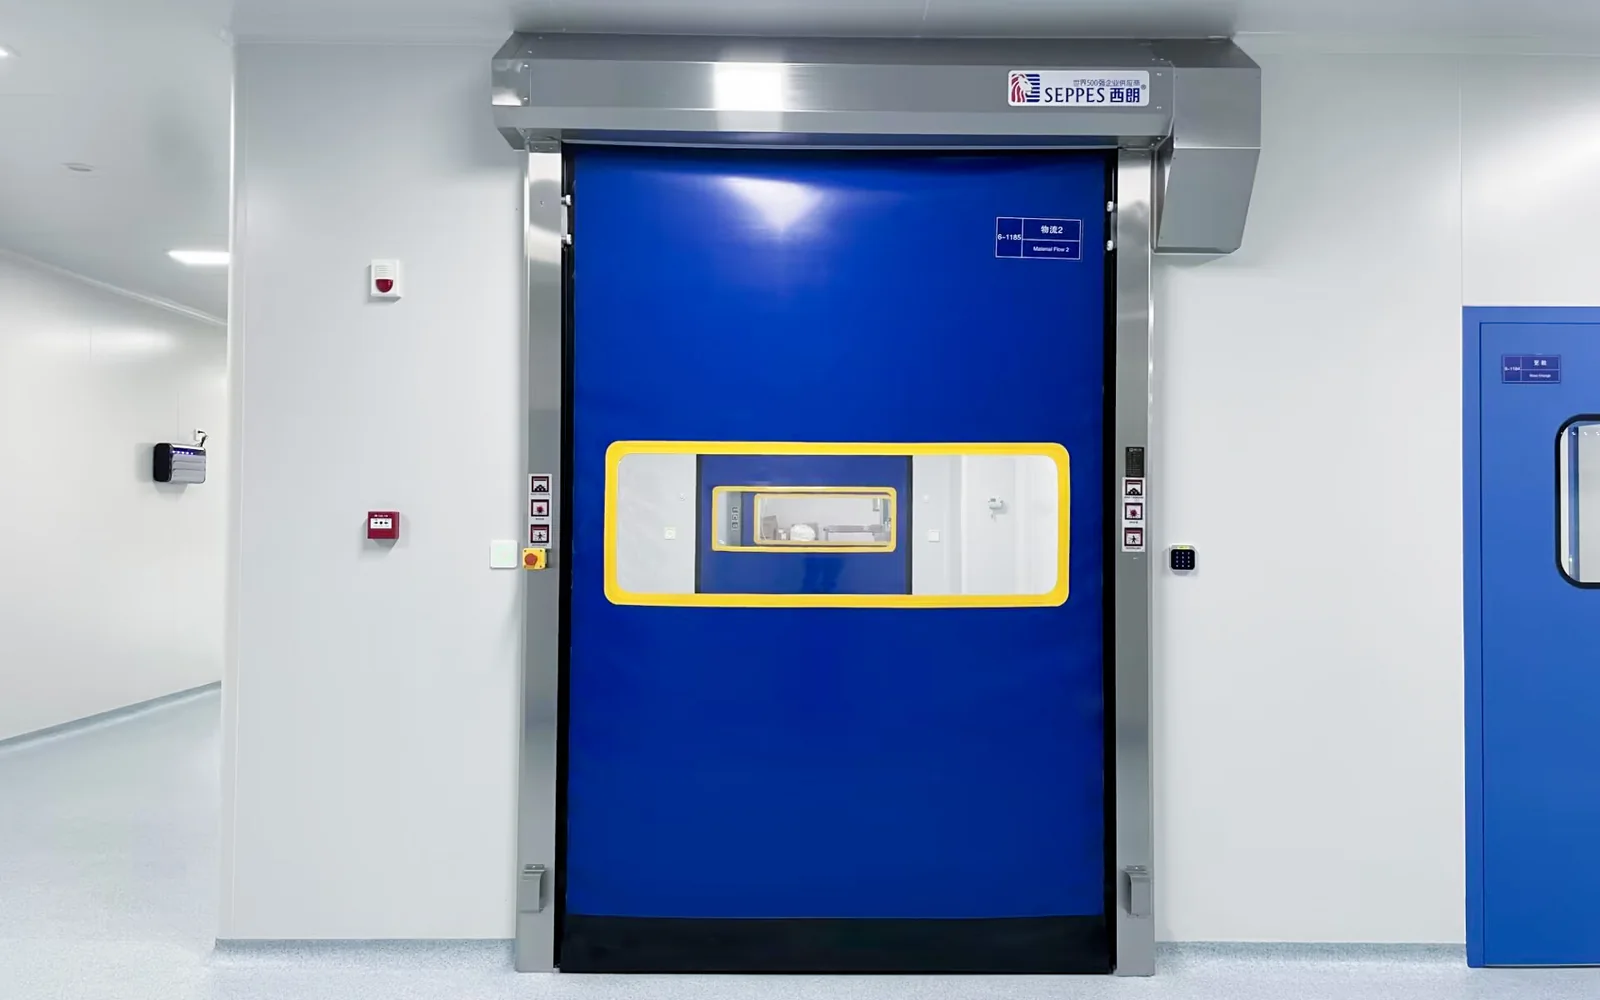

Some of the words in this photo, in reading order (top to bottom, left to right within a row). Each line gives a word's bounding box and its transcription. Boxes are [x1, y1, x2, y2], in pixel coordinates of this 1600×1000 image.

[1044, 87, 1105, 103] SEPPES
[1110, 87, 1140, 103] 西朗
[1040, 225, 1063, 234] 物流2
